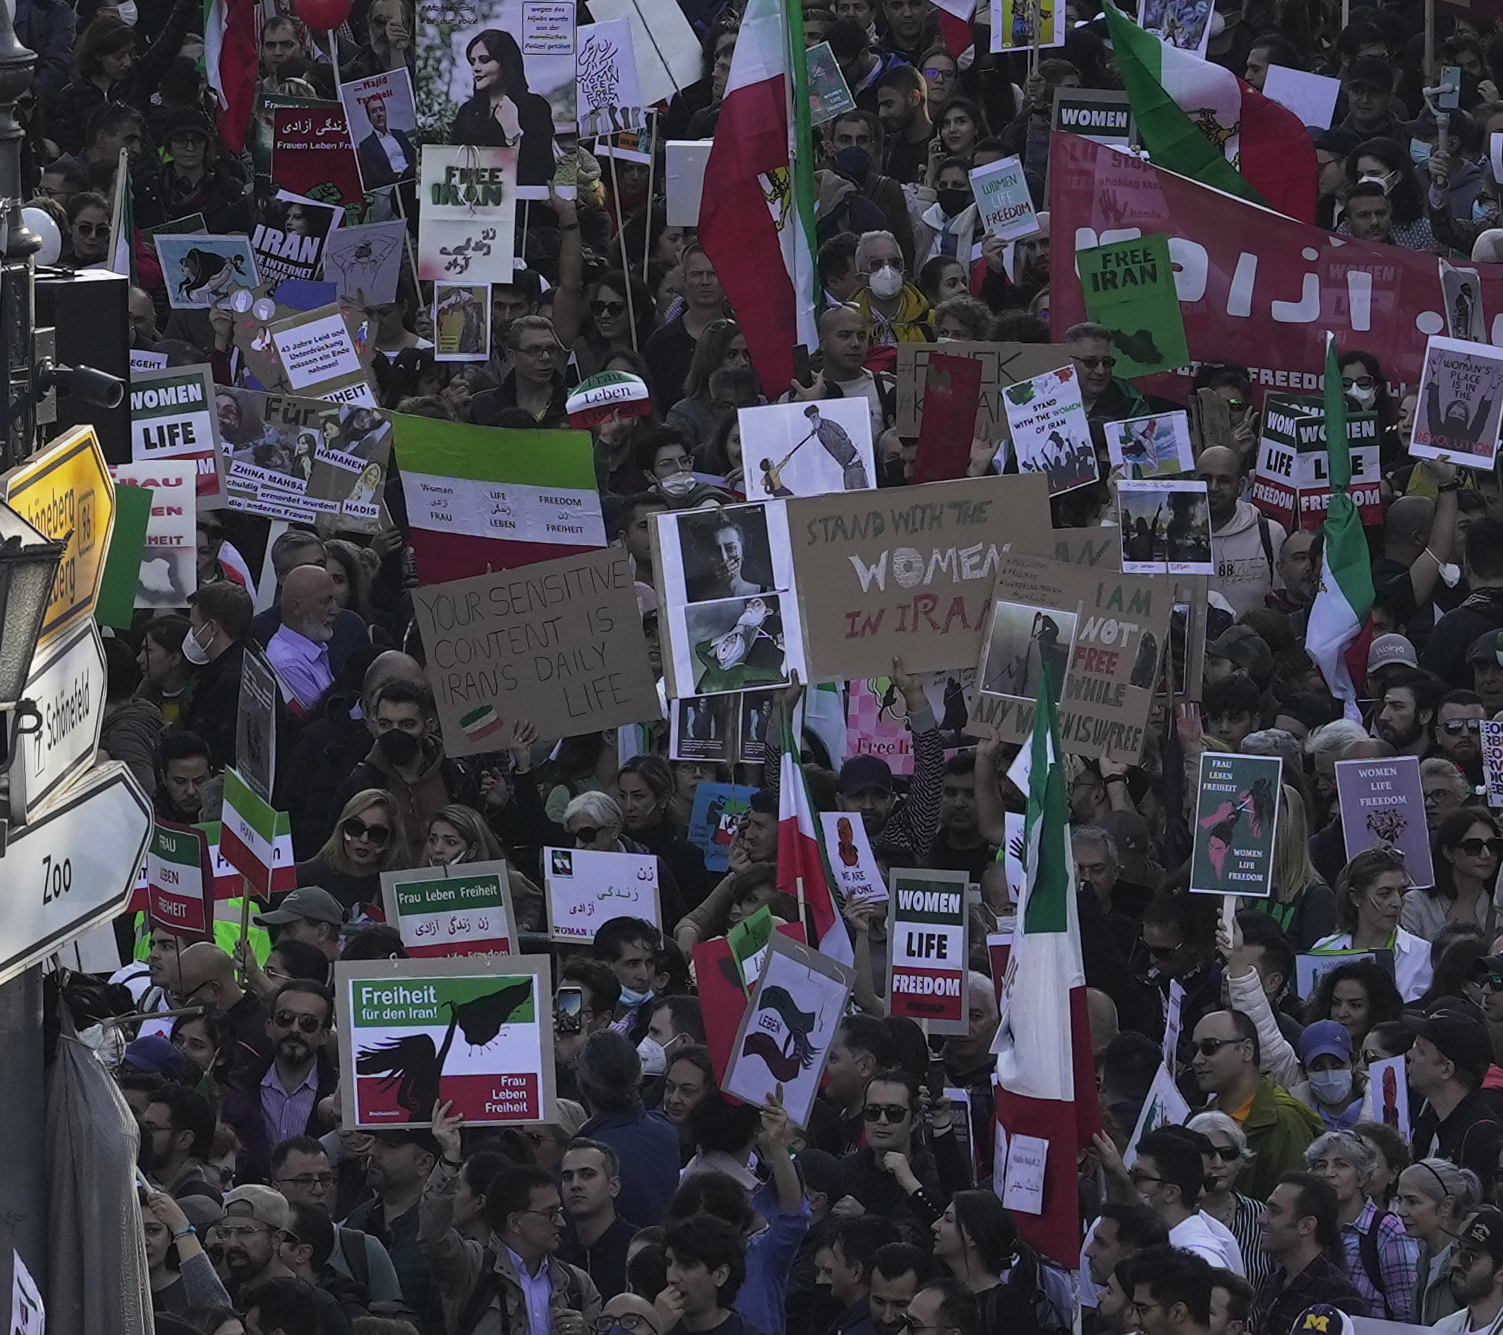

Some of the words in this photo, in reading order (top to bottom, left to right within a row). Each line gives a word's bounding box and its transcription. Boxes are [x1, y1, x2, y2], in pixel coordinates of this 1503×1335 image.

[1100, 246, 1156, 270] FREE
[1091, 263, 1158, 293] IRAN
[807, 511, 885, 545] STAND
[889, 504, 944, 536] WITH
[952, 499, 989, 526] THE
[847, 541, 1013, 593] WOMEN
[418, 590, 484, 637] YOUR
[488, 557, 629, 617] SENSITIVE
[433, 617, 564, 670] CONTENT
[587, 606, 615, 637] IS
[46, 666, 90, 750] Schönefeld
[562, 672, 633, 719] LIFE
[41, 853, 72, 906] Zoo
[398, 891, 421, 905] Frau
[425, 887, 456, 902] Leben
[460, 883, 498, 899] Freiheit
[898, 889, 961, 914] WOMEN
[906, 931, 948, 960] LIFE
[360, 986, 437, 1005] Freiheit
[892, 974, 961, 997] FREEDOM
[361, 1007, 379, 1021] für
[383, 1006, 406, 1020] den
[408, 1006, 438, 1019] Iran!
[492, 1089, 527, 1100] Leben
[500, 1076, 527, 1087] Frau
[485, 1101, 527, 1114] Freiheit
